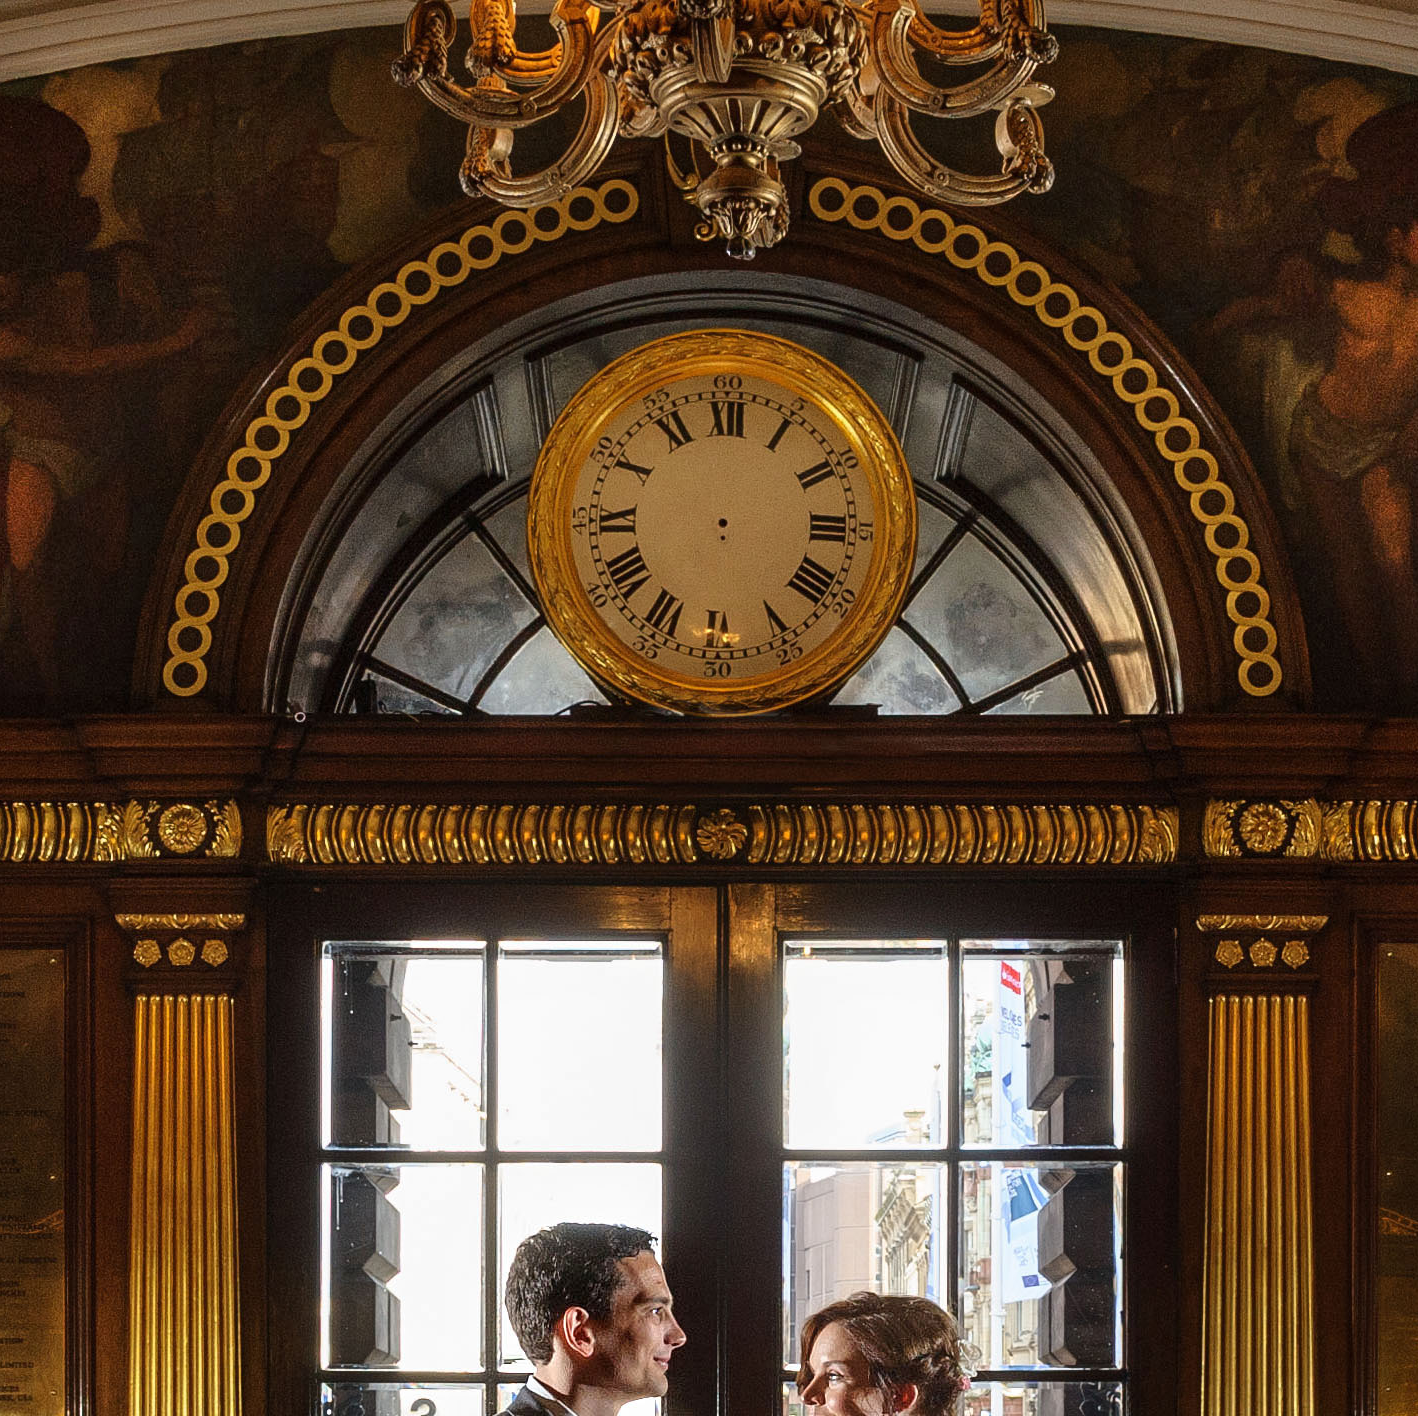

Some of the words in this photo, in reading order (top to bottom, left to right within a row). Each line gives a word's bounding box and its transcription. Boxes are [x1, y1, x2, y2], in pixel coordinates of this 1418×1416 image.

[714, 376, 742, 390] 60
[643, 388, 671, 409] 55
[790, 395, 807, 412] 5
[654, 410, 696, 453] XI
[708, 401, 747, 438] XII
[590, 436, 613, 463] 50
[765, 418, 793, 452] I
[615, 450, 654, 485] X
[840, 446, 859, 470] 10
[795, 461, 836, 492] II
[572, 506, 587, 534] 45
[600, 504, 638, 535] IX
[810, 511, 847, 543] III
[859, 520, 874, 543] 15
[604, 542, 653, 602] VIII
[786, 552, 838, 606] IIII
[586, 584, 608, 609] 40
[833, 588, 857, 617] 20
[644, 588, 684, 639] VII
[763, 600, 790, 638] V
[632, 636, 661, 659] 35
[776, 641, 804, 666] 25
[703, 662, 732, 678] 30
